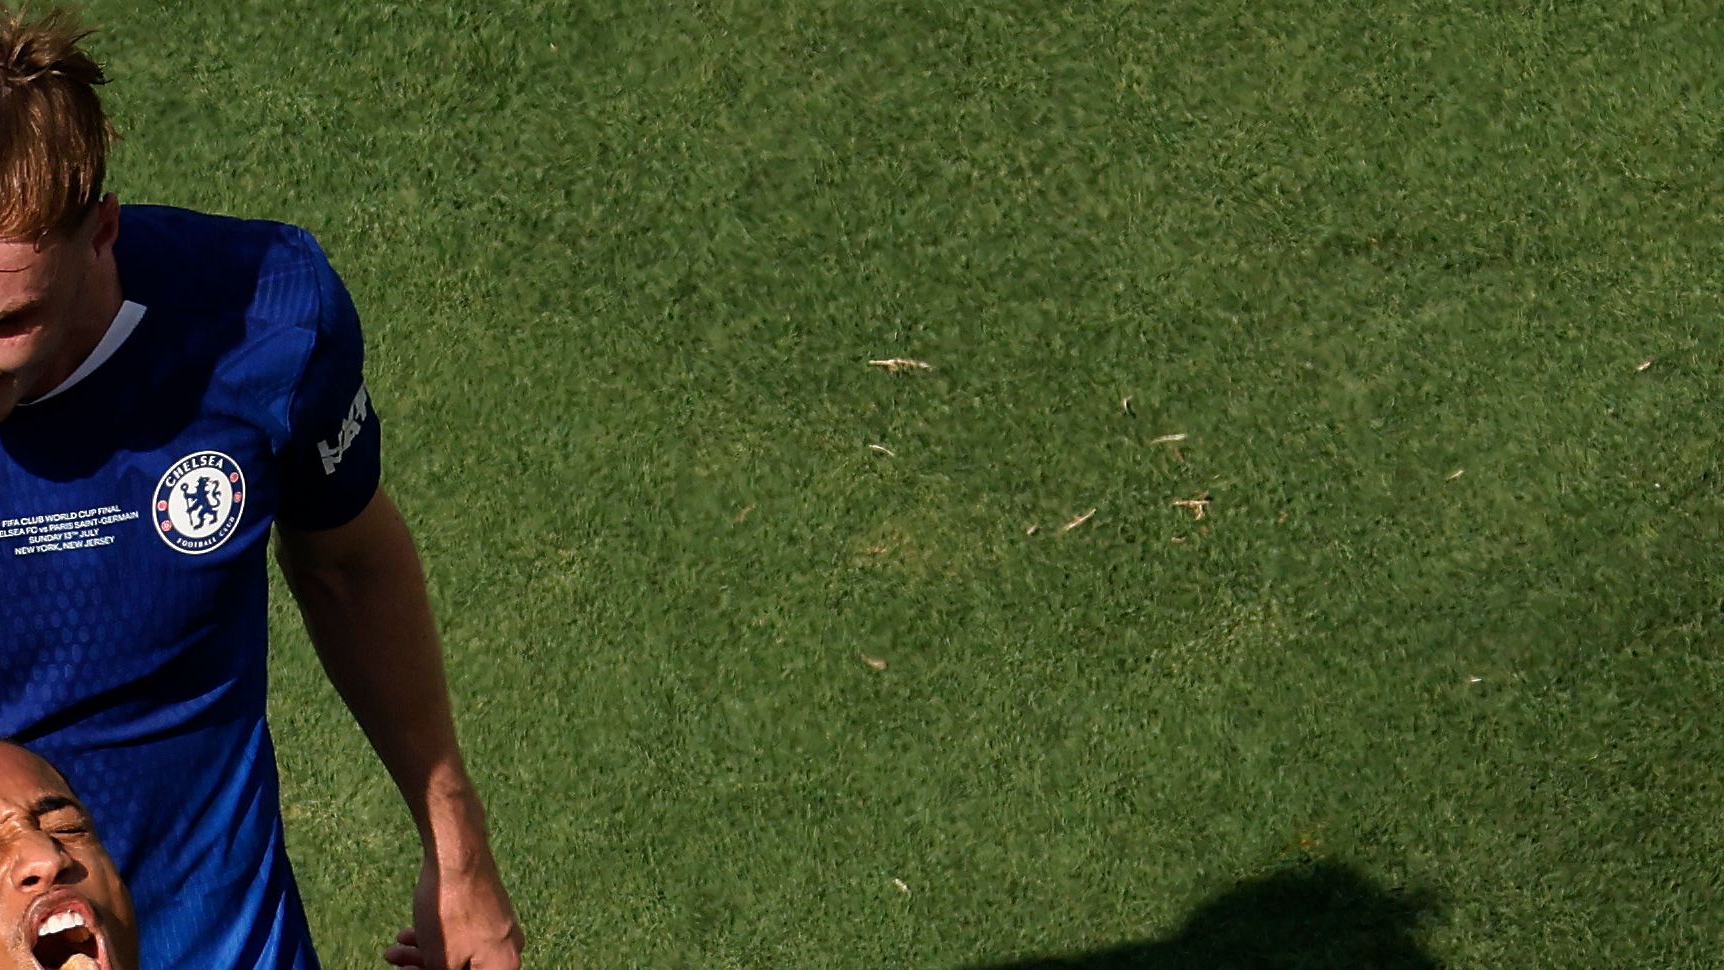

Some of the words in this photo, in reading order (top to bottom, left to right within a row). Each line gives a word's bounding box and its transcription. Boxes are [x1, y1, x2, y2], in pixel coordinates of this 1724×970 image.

[165, 455, 224, 487] CHELSEA
[2, 517, 20, 528] FIFA
[21, 515, 44, 526] CLUB
[45, 512, 77, 523] WORLD
[78, 509, 96, 519] CUP
[98, 505, 121, 515] FINAL
[26, 526, 38, 535] FC
[49, 522, 73, 532] PARIS
[74, 511, 139, 529] SAINT-GERMAIN
[218, 516, 235, 537] CLUB
[14, 546, 35, 556] NEW
[63, 540, 83, 550] NEW
[84, 536, 115, 548] JERSEY
[29, 534, 62, 544] SUNDAY
[79, 528, 99, 538] JULY
